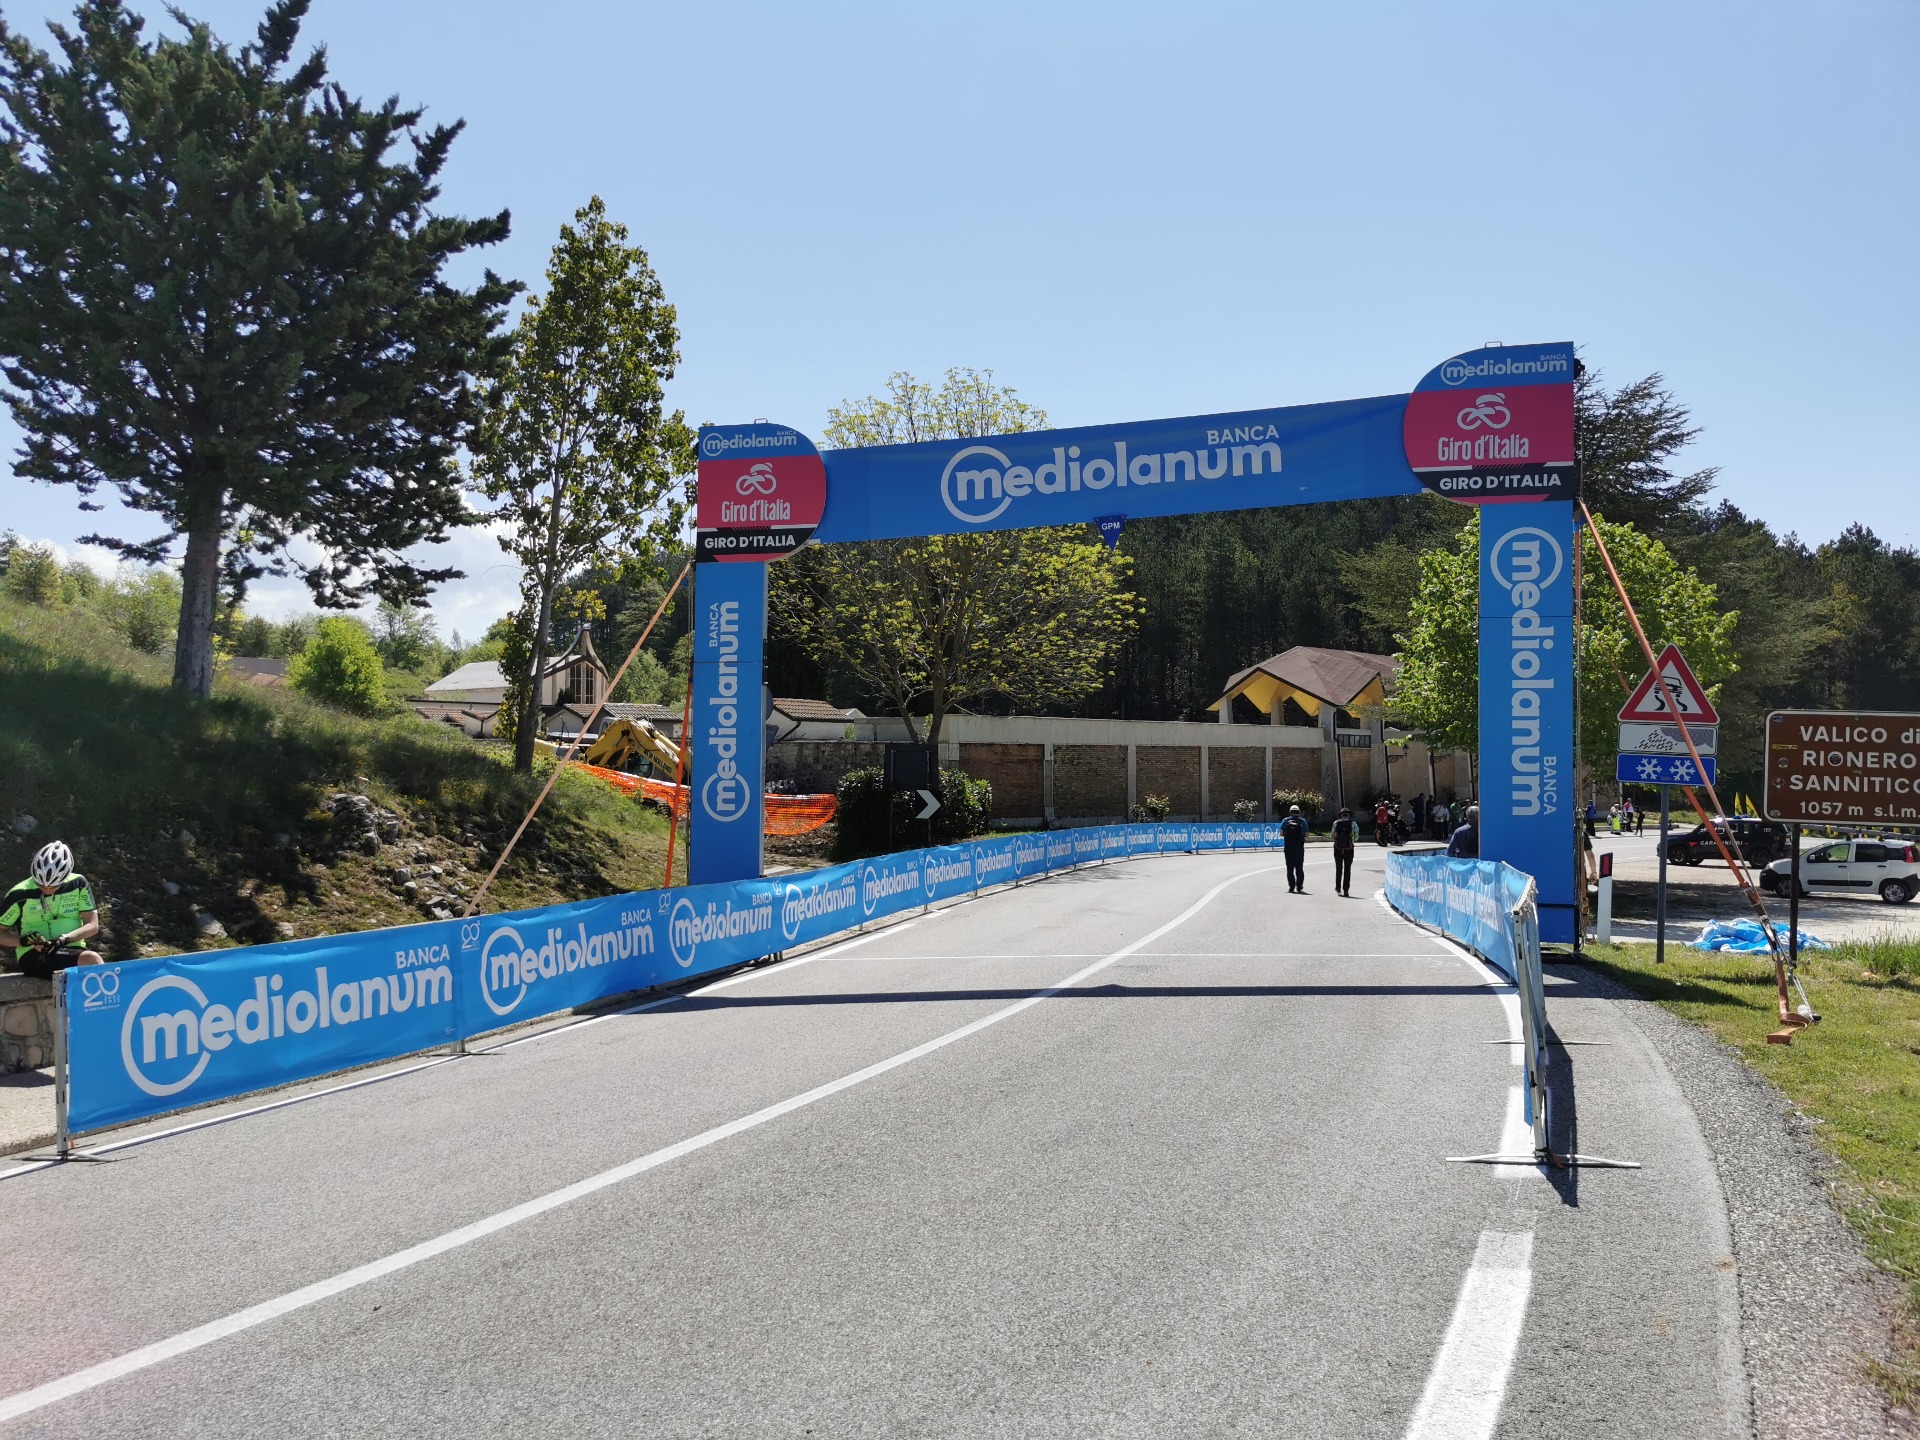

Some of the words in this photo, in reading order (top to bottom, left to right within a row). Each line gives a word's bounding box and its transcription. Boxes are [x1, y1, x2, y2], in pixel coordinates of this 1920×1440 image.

[1446, 358, 1568, 378] mediolanum
[1540, 353, 1567, 361] BANCA
[706, 433, 797, 450] mediolanum
[1206, 424, 1280, 446] BANCA
[1438, 436, 1472, 462] Giro
[1475, 433, 1529, 460] d'Italia
[955, 441, 1282, 502] mediolanum
[1439, 476, 1483, 491] GIRO
[1486, 473, 1562, 489] D'ITALIA
[721, 501, 748, 523] Giro
[749, 498, 791, 521] d'Italia
[1101, 522, 1121, 530] GPM
[704, 537, 737, 549] GIRO
[740, 534, 796, 548] D'ITALIA
[709, 602, 719, 648] BANCA
[1511, 539, 1554, 816] mediolanum
[709, 601, 739, 811] mediolanum
[1800, 725, 1888, 743] VALICO
[1900, 728, 1920, 744] di
[1802, 750, 1917, 768] RIONERO
[1543, 755, 1557, 815] BANCA
[1800, 801, 1842, 815] 1057
[1848, 805, 1864, 816] m
[841, 874, 856, 886] BANCA
[927, 857, 971, 886] mediolanum
[866, 867, 919, 902] mediolanum
[752, 891, 773, 906] BANCA
[786, 883, 856, 925] mediolanum
[621, 908, 652, 926] BANCA
[675, 900, 773, 948] mediolanum
[395, 944, 450, 969] BANCA
[490, 922, 655, 991] mediolanum
[140, 965, 453, 1064] mediolanum
